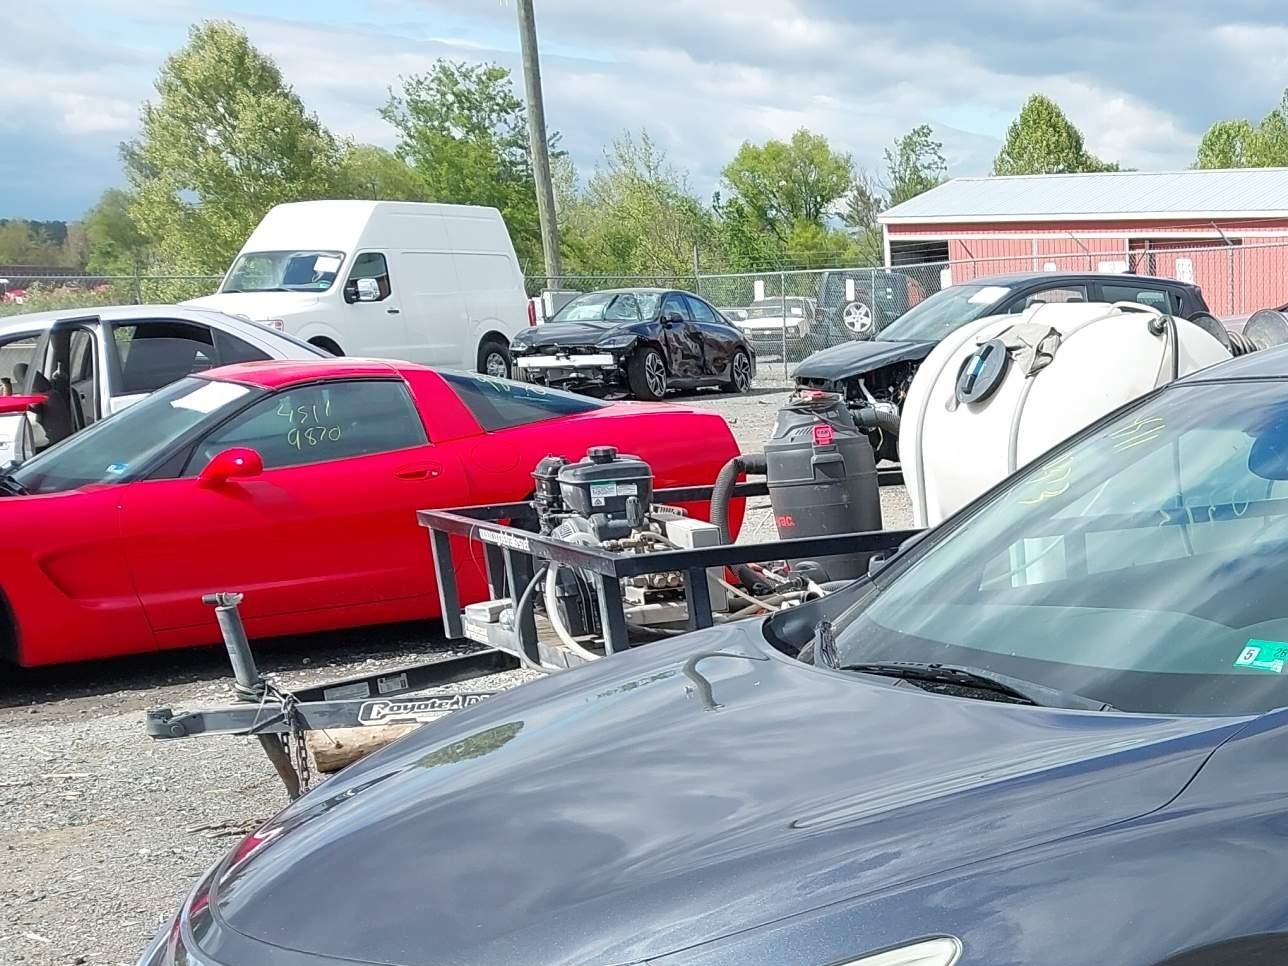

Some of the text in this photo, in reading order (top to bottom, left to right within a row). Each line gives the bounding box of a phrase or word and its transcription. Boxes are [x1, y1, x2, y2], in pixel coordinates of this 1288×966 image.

[277, 400, 330, 424] 4511
[287, 425, 341, 450] 9870
[1244, 649, 1256, 660] 5
